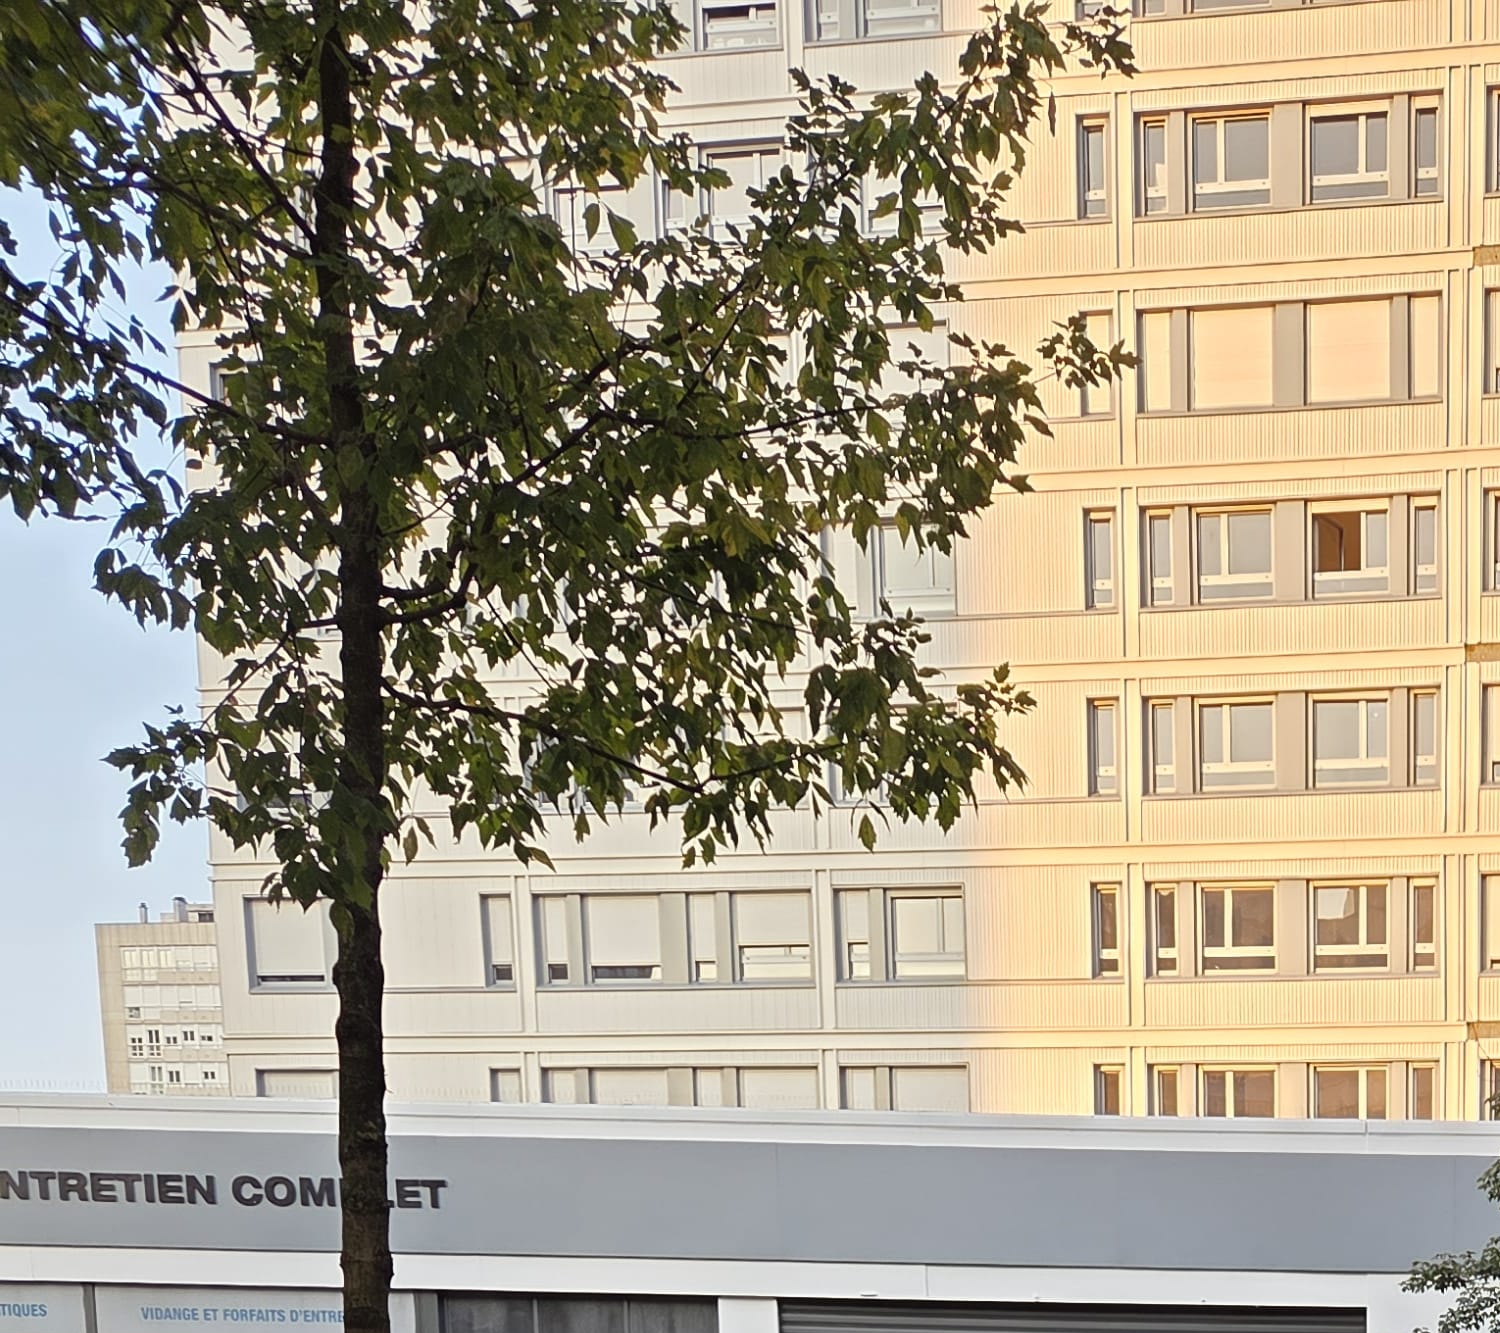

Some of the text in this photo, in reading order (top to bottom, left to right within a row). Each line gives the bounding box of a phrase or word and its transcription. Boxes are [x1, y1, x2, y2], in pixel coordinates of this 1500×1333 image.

[232, 1175, 448, 1209] COMET
[140, 1307, 199, 1321] VIDANGE
[203, 1308, 218, 1321] ET
[223, 1309, 286, 1322] FORFAITS
